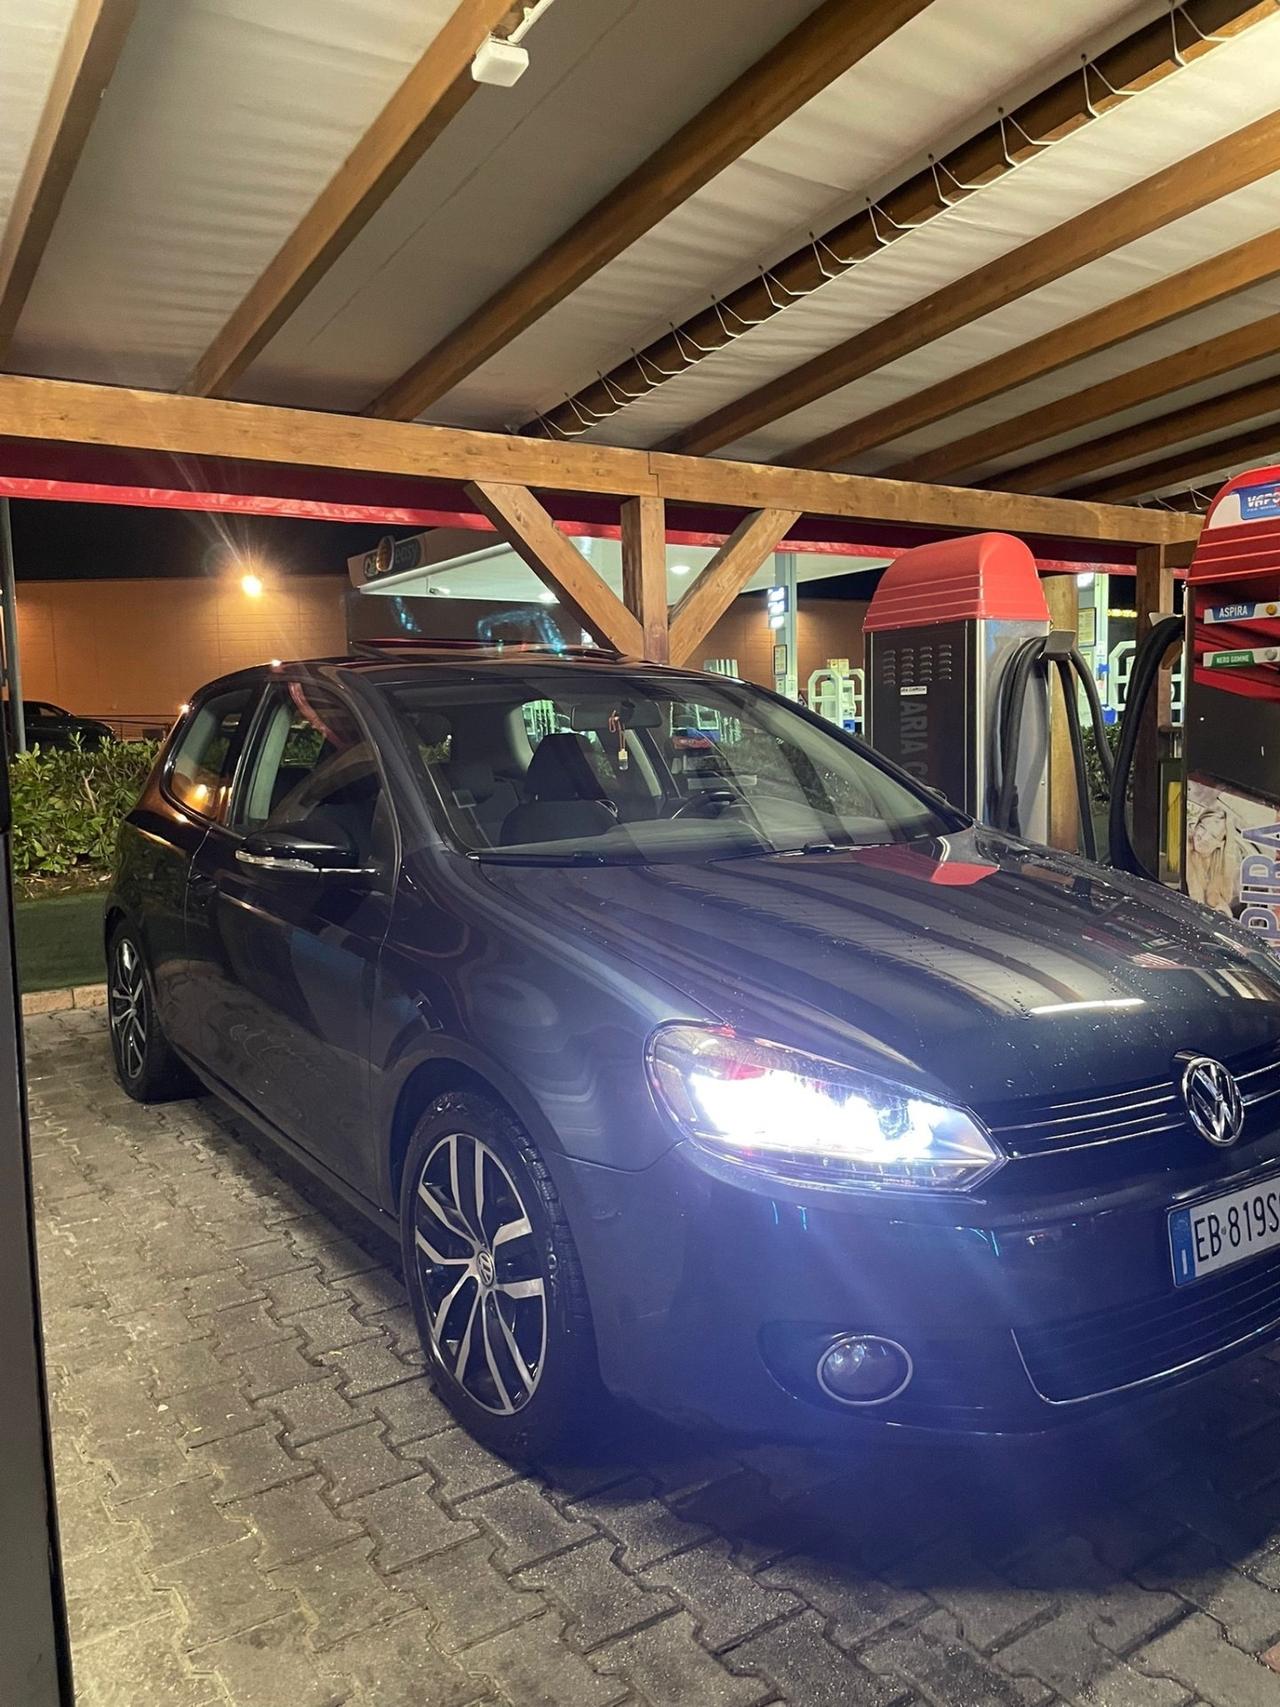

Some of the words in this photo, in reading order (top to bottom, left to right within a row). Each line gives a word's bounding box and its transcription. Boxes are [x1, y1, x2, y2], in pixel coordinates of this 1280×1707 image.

[1219, 605, 1248, 618] ASPIRA
[900, 700, 929, 755] ARIA
[1239, 821, 1280, 952] PIRA
[1227, 1192, 1280, 1248] 819S
